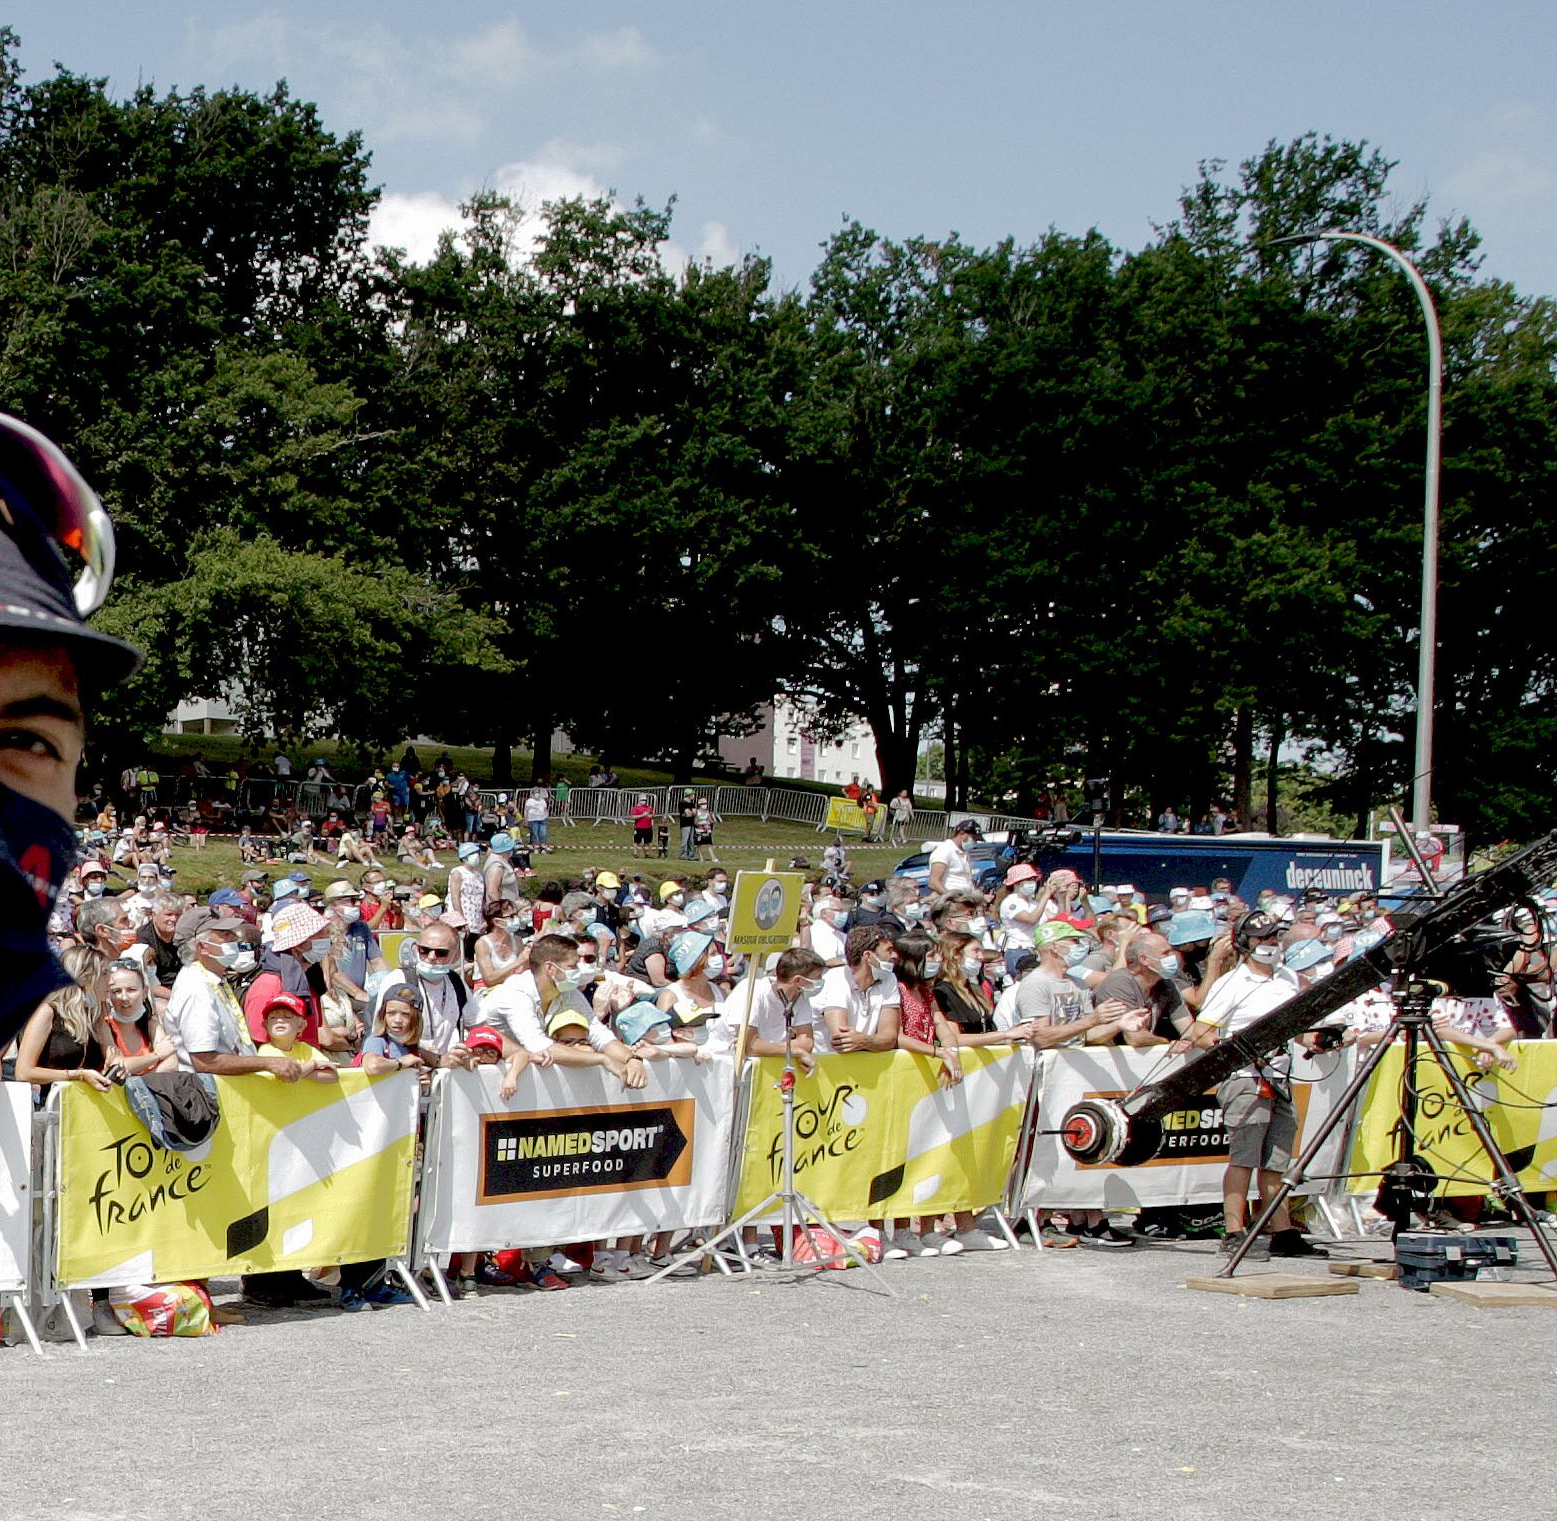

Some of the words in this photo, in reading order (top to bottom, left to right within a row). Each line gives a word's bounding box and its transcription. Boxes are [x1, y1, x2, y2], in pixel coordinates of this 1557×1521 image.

[1286, 860, 1374, 890] deceuninck
[827, 1121, 843, 1136] de
[518, 1126, 658, 1160] NAMEDSPORT
[1168, 1134, 1231, 1148] ERFOOD
[165, 1154, 183, 1175] de
[532, 1158, 625, 1179] SUPERFOOD
